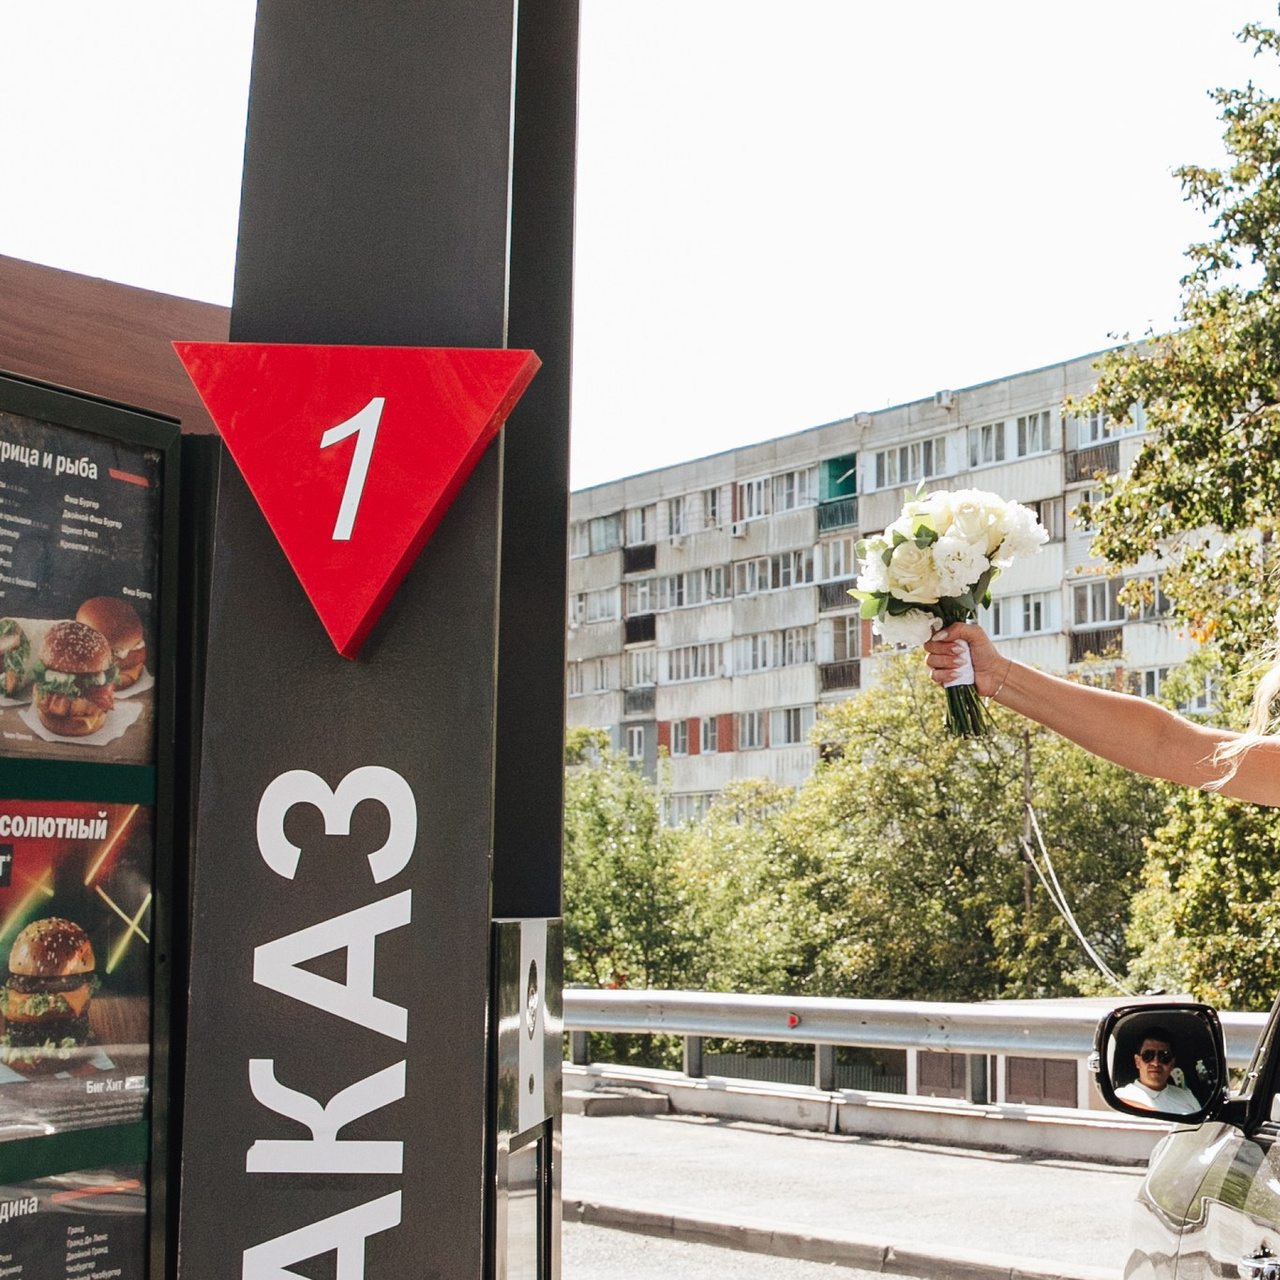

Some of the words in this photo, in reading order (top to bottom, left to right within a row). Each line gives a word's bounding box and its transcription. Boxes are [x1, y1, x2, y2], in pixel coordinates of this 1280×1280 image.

[0, 441, 39, 468] рица
[42, 452, 53, 469] и
[55, 455, 98, 480] рыба
[320, 397, 386, 541] 1
[86, 1081, 105, 1094] Биг
[106, 1078, 123, 1092] Хит
